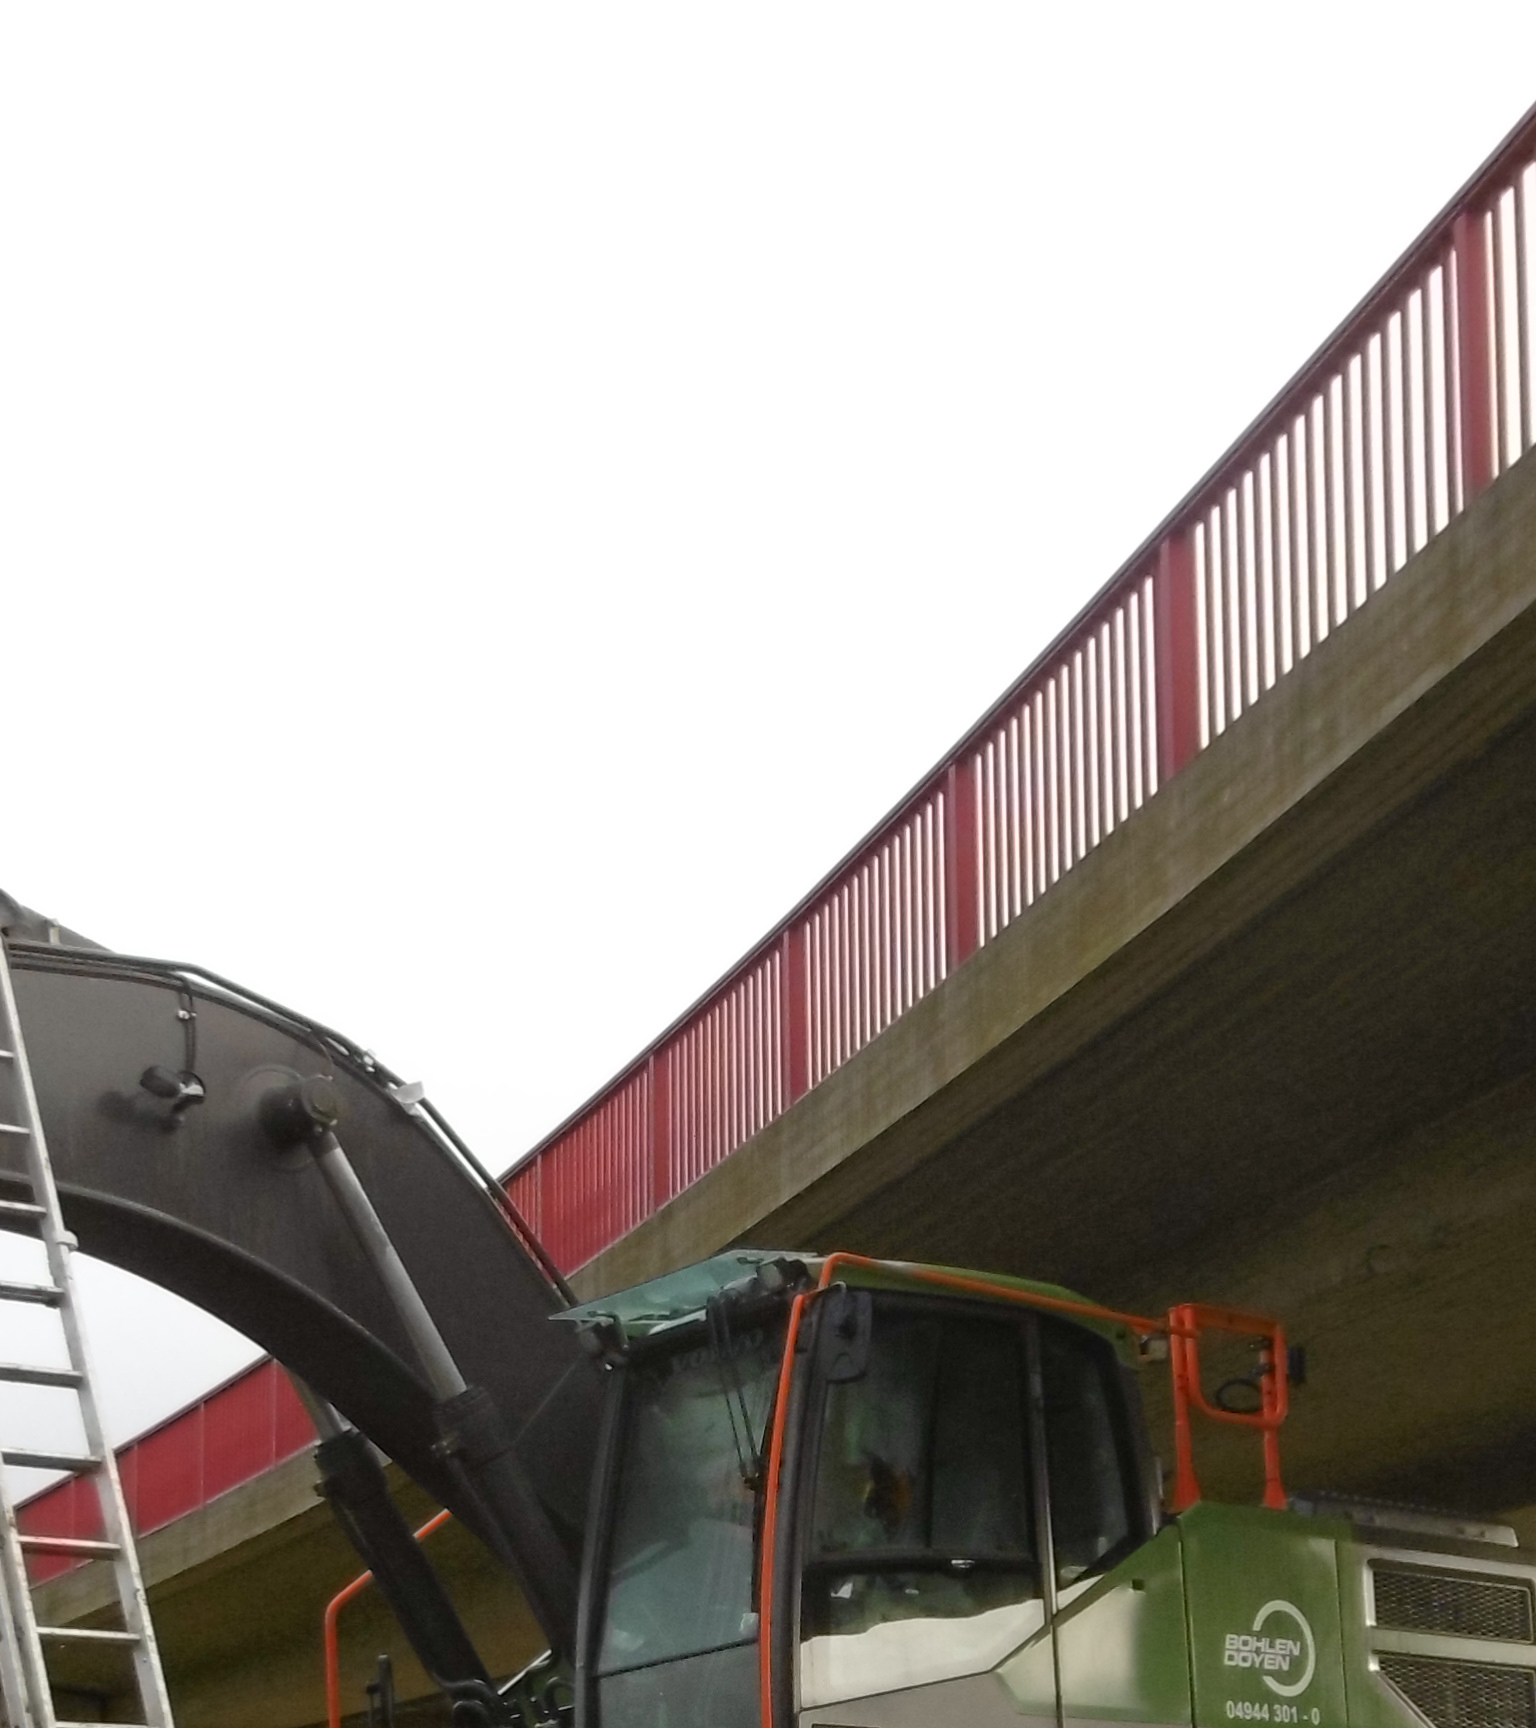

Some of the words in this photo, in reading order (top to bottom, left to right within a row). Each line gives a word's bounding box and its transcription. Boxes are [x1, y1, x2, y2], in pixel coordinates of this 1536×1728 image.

[1224, 1633, 1301, 1656] BOHLEN
[1223, 1650, 1290, 1672] DOYEN
[1225, 1700, 1270, 1721] 04944
[1273, 1704, 1299, 1724] 301
